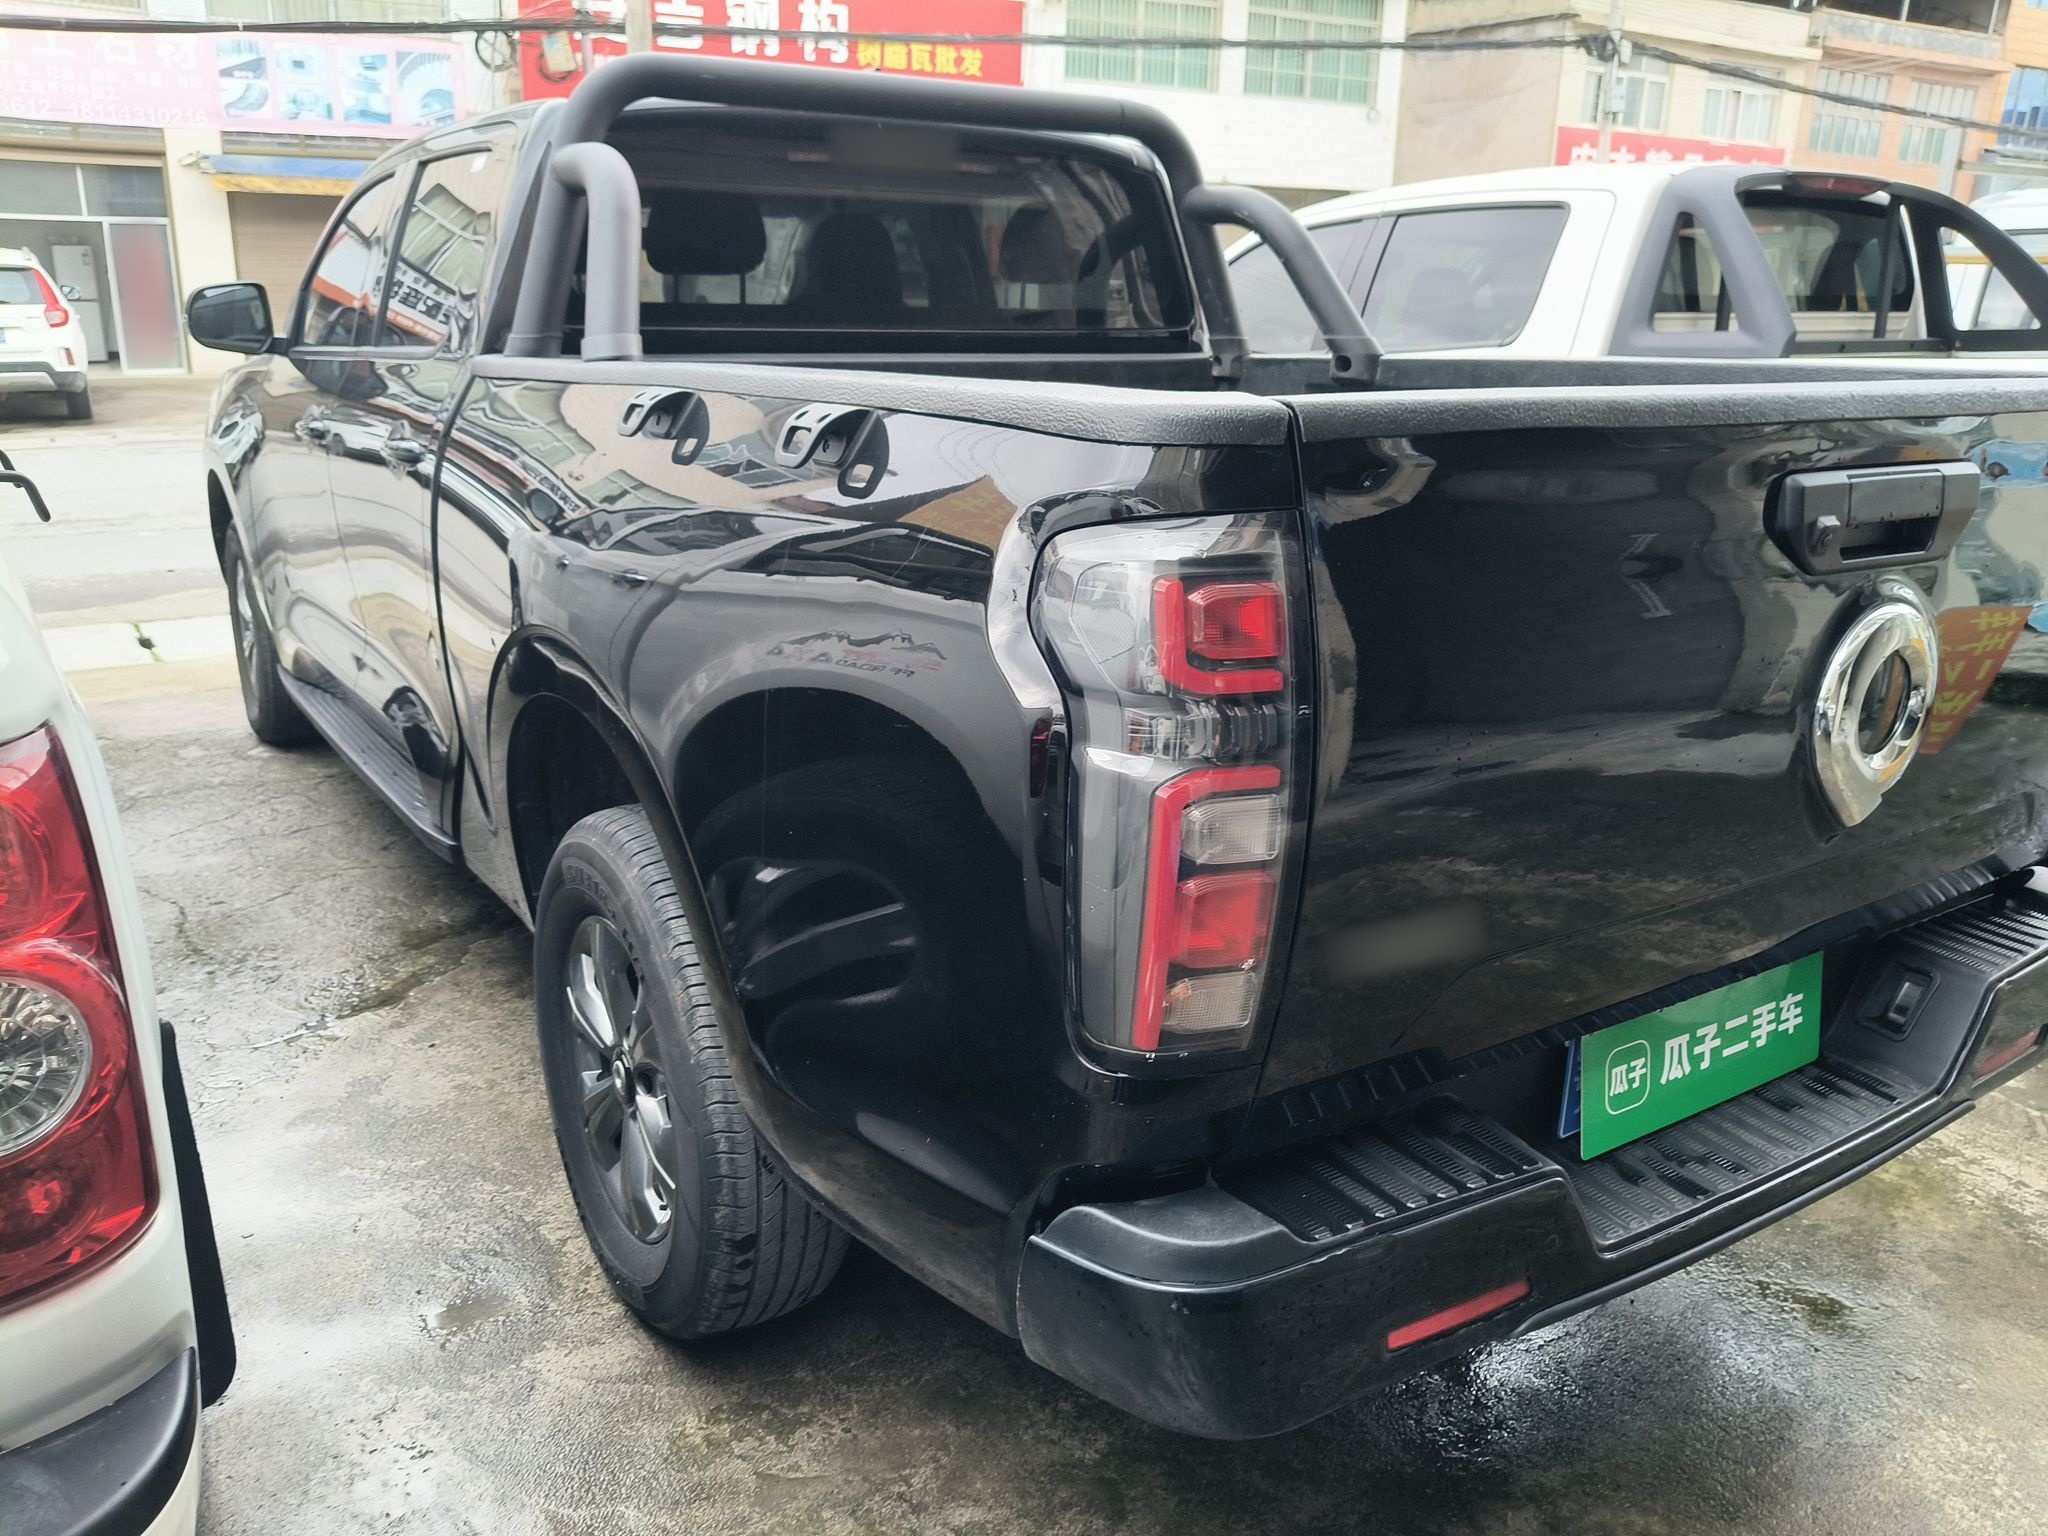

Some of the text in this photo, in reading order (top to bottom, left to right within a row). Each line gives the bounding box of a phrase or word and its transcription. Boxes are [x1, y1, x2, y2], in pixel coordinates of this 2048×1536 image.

[1609, 1057, 1647, 1097] 瓜子
[1659, 992, 1804, 1085] 瓜子二手车
